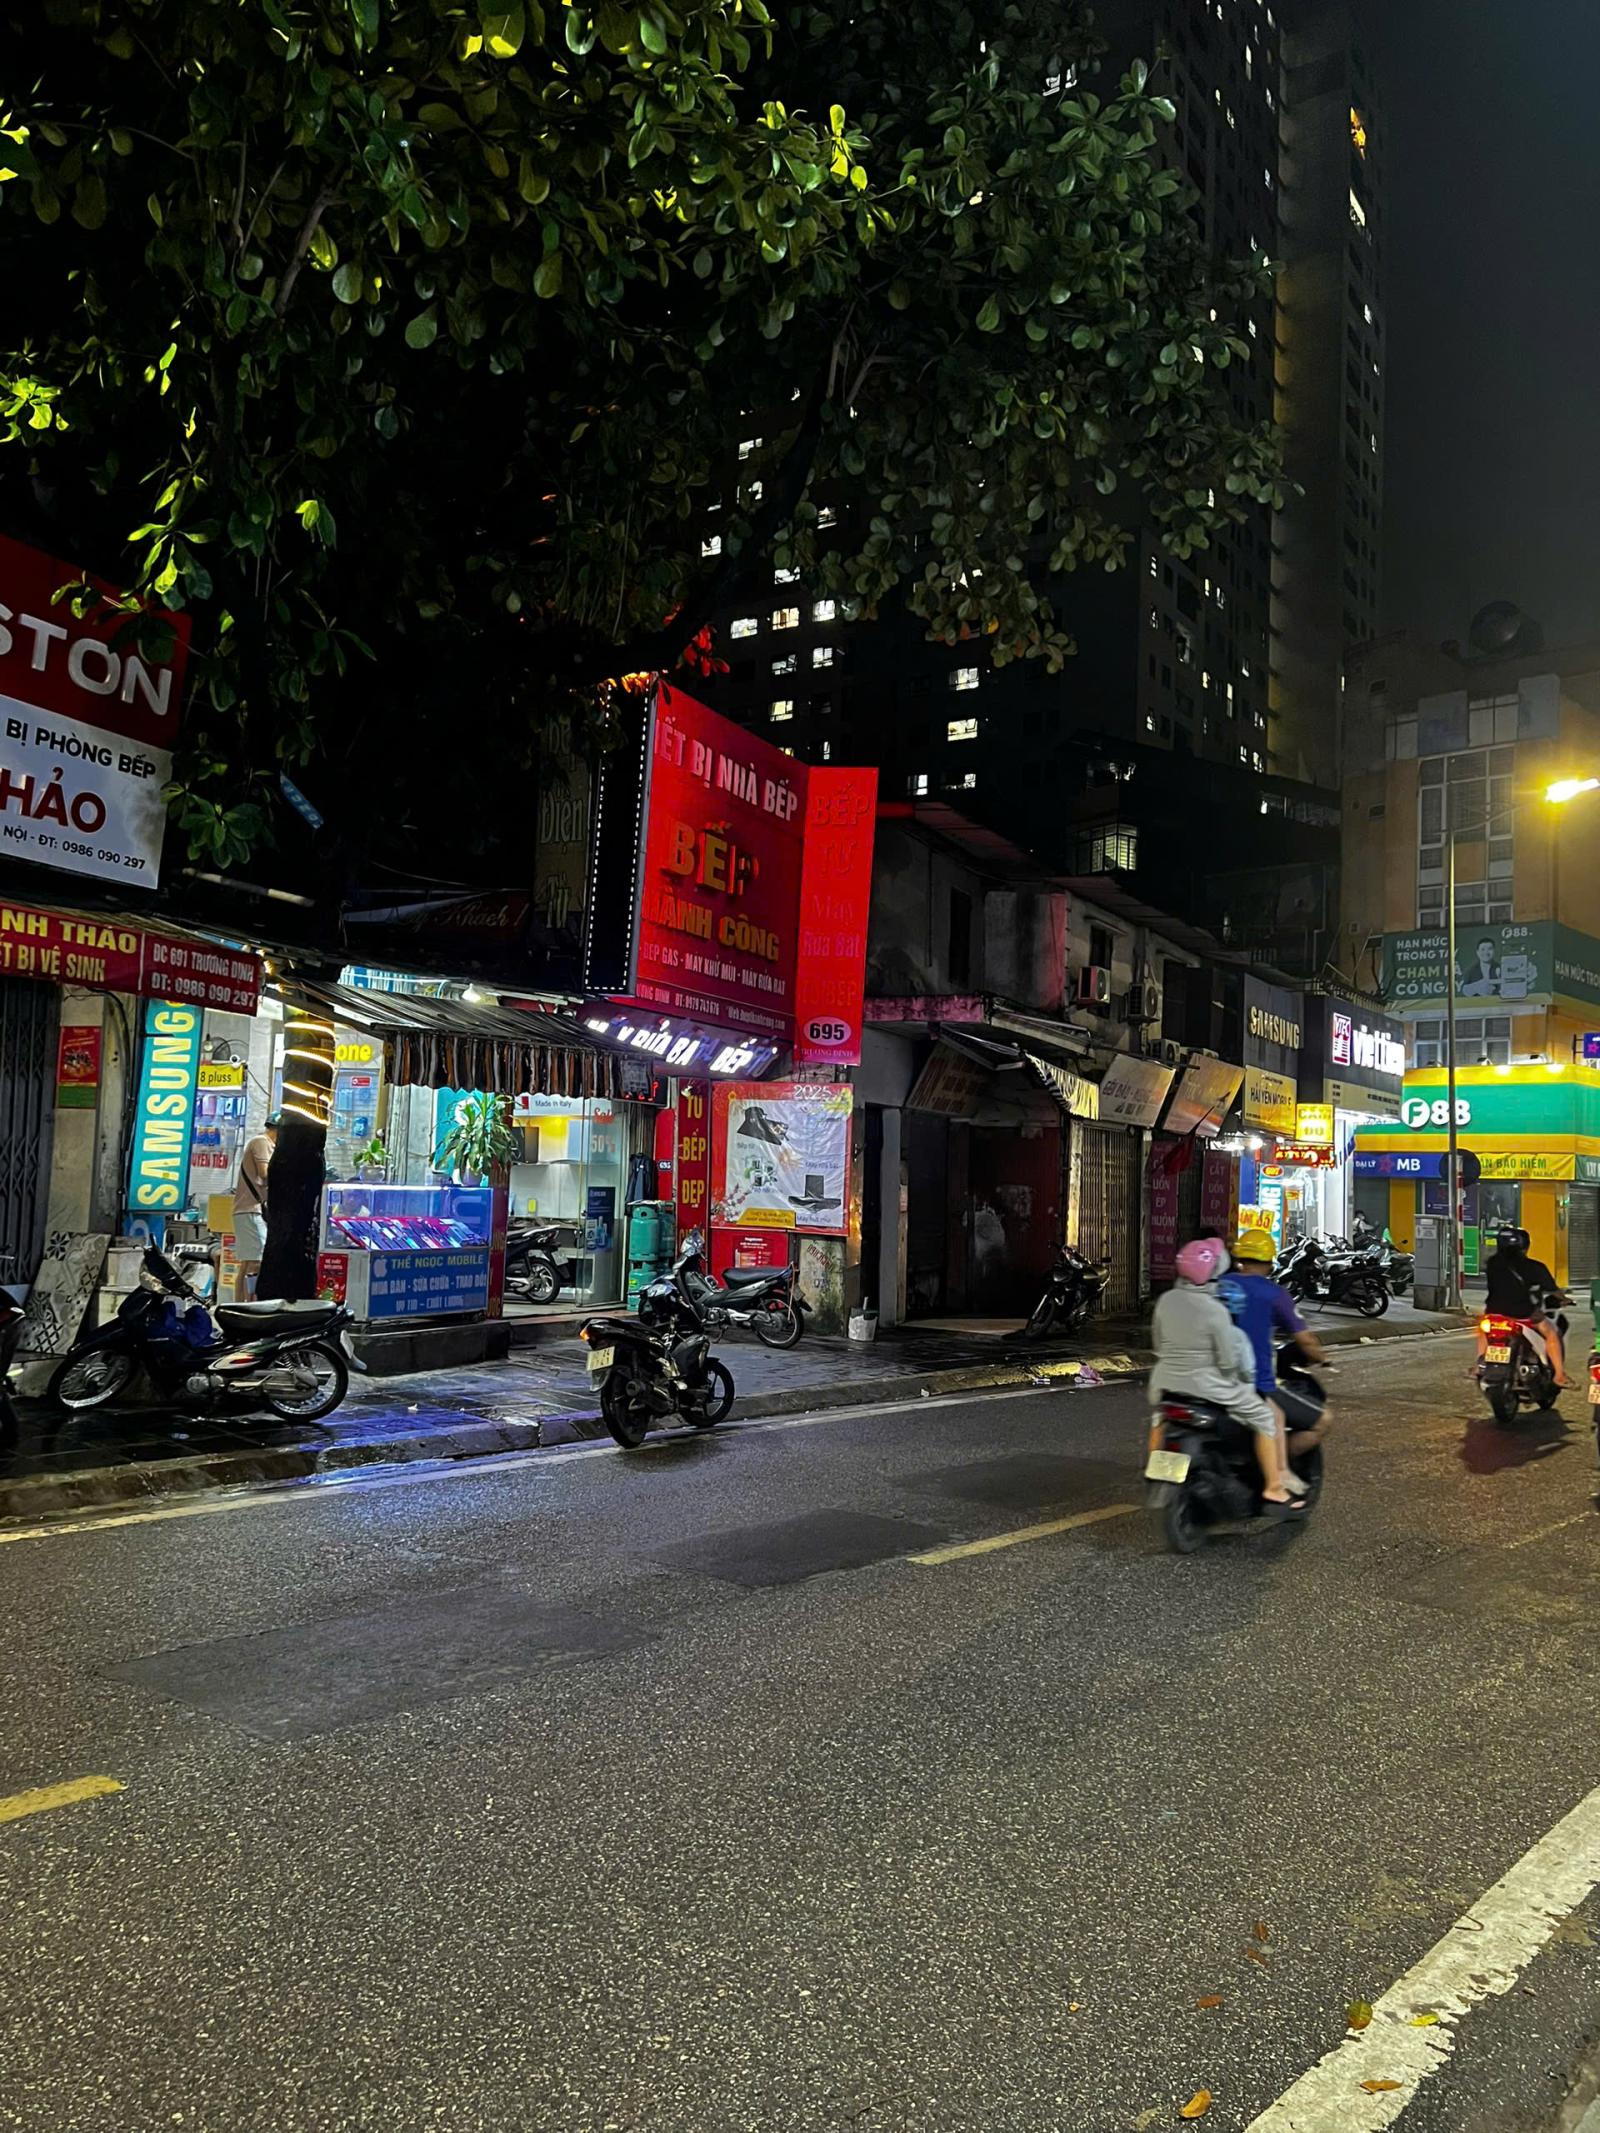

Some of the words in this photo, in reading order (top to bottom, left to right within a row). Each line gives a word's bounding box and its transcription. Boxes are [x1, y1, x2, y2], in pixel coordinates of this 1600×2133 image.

[6, 718, 28, 747] BỊ
[35, 727, 113, 767] PHÒNG
[118, 753, 157, 779] BẾP
[691, 740, 713, 789] BỊ
[716, 754, 758, 806] NHÀ
[763, 779, 798, 822] BẾP
[3, 824, 28, 844] NỘI
[62, 840, 94, 858] 0986
[97, 849, 121, 864] 090
[124, 855, 146, 870] 297
[664, 821, 759, 896] BẾP
[59, 919, 138, 954] THẢO
[718, 914, 780, 961] CÔNG
[1396, 939, 1420, 951] HẠN
[1422, 935, 1448, 948] MỨC
[1501, 927, 1528, 939] F88
[17, 942, 36, 977] BỊ
[40, 944, 61, 981] VỆ
[65, 952, 106, 982] SINH
[170, 946, 188, 968] 691
[661, 947, 678, 967] GAS
[1395, 950, 1437, 961] TRONG
[1396, 965, 1441, 982] CHẠM
[175, 977, 206, 999] 0986
[209, 982, 231, 1004] 090
[233, 988, 257, 1009] 297
[1396, 979, 1419, 996] CÓ
[1422, 979, 1465, 994] NGY
[809, 1022, 845, 1041] 695
[1250, 1006, 1300, 1050] SAMSUNG
[335, 1044, 372, 1061] one
[200, 1072, 206, 1082] 8
[793, 1084, 832, 1100] 2025
[137, 1009, 197, 1207] SAMSUNG
[535, 1100, 551, 1108] Made
[560, 1100, 572, 1109] Italy
[1401, 1098, 1472, 1128] F88
[682, 1129, 706, 1161] BẾP
[1396, 1158, 1421, 1172] MB
[681, 1180, 705, 1208] ĐẸP
[447, 1254, 484, 1266] MOBILE
[456, 1275, 473, 1289] TRAO
